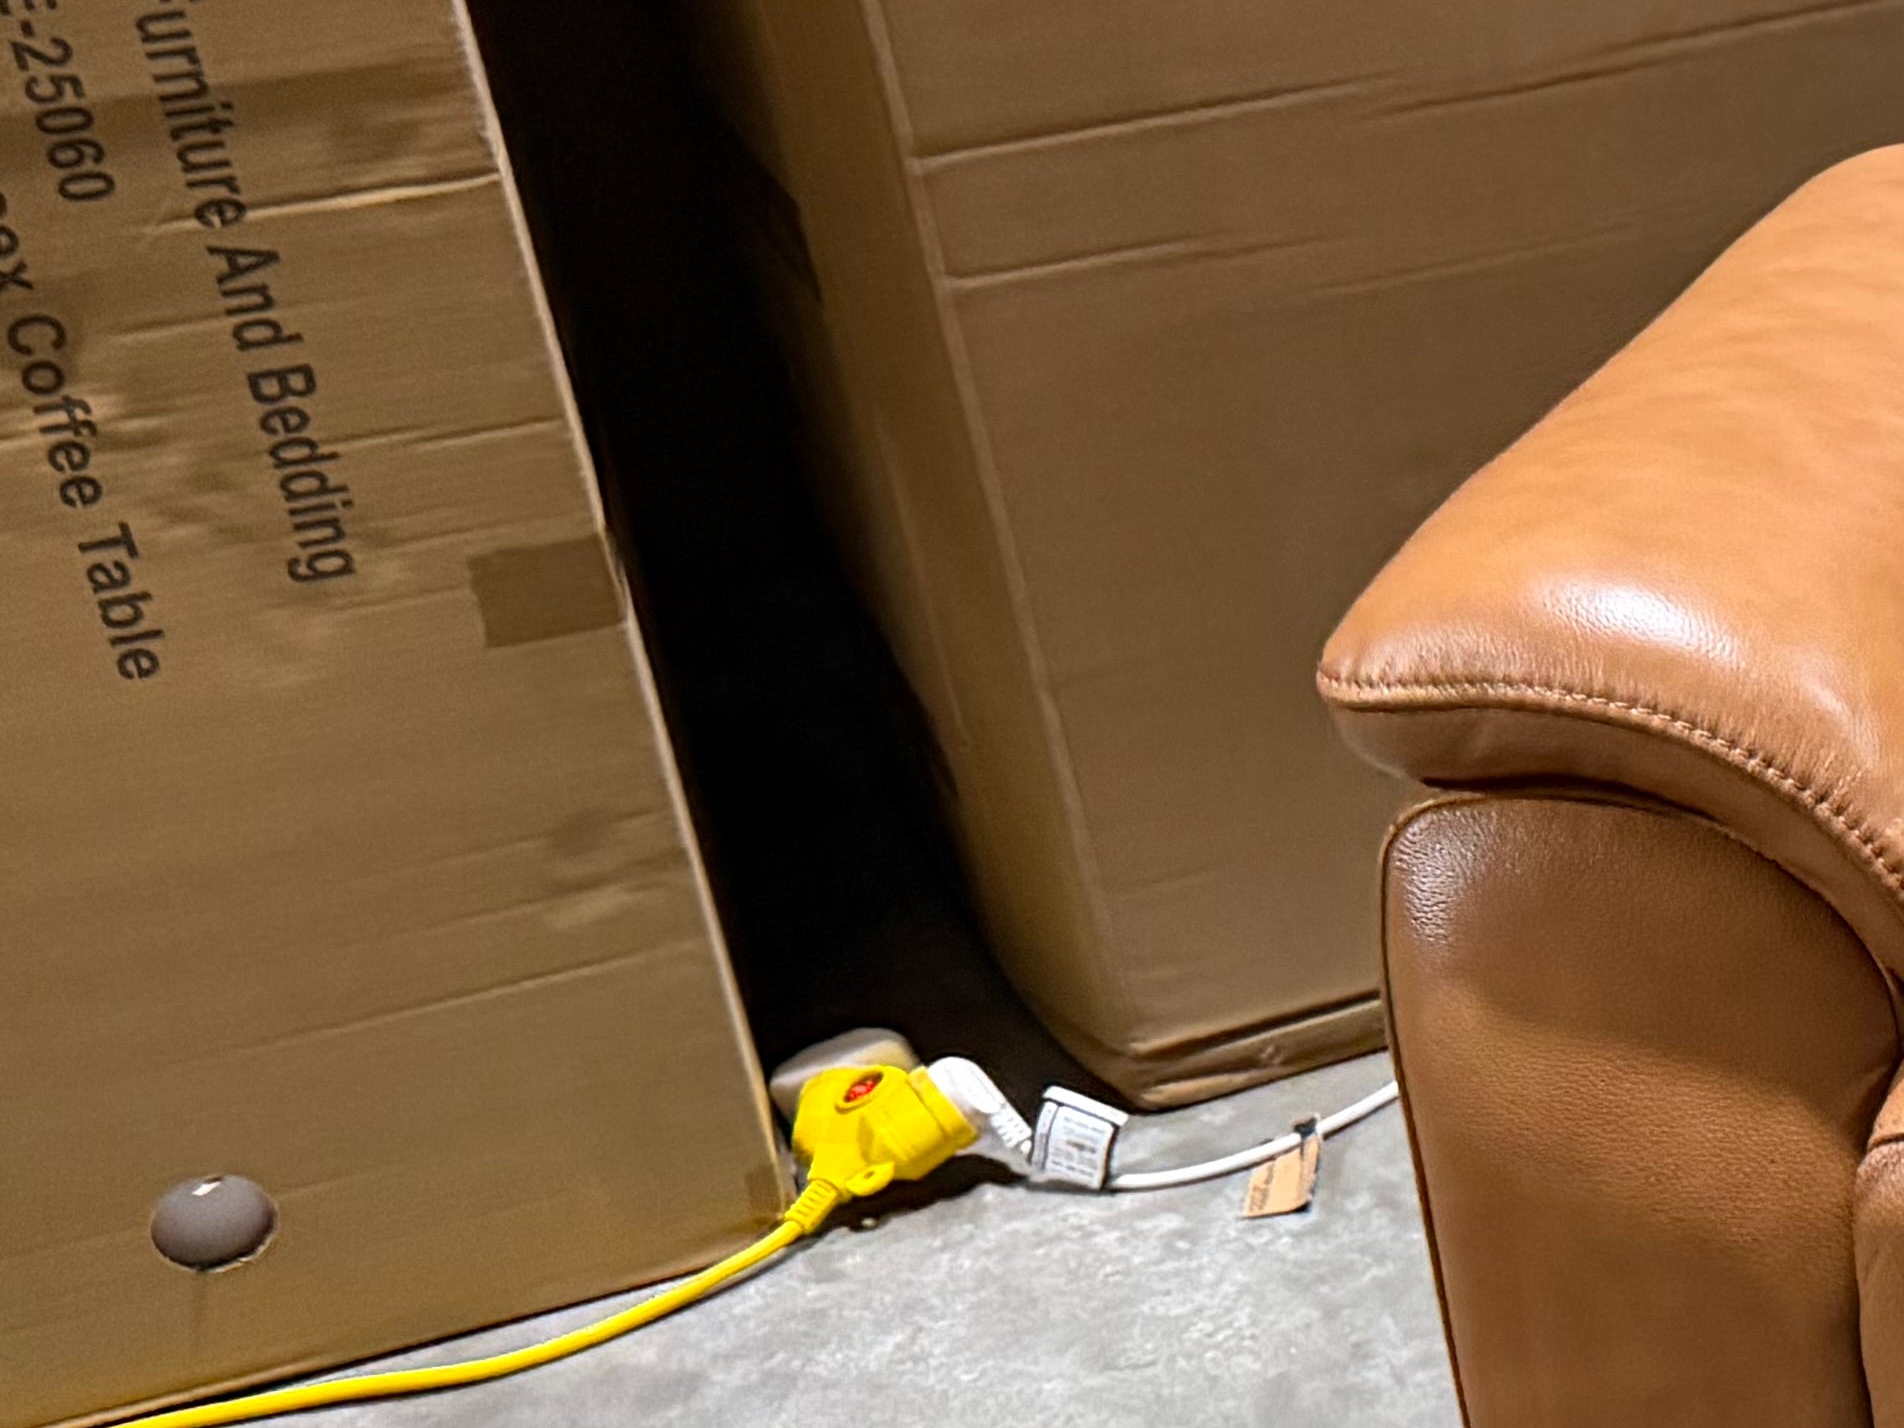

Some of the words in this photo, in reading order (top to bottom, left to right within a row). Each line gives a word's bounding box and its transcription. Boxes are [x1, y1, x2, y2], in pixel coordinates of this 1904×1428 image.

[206, 235, 302, 353] And
[6, 312, 105, 510] Coffee
[76, 522, 162, 684] Table
[246, 362, 359, 586] Bedding
